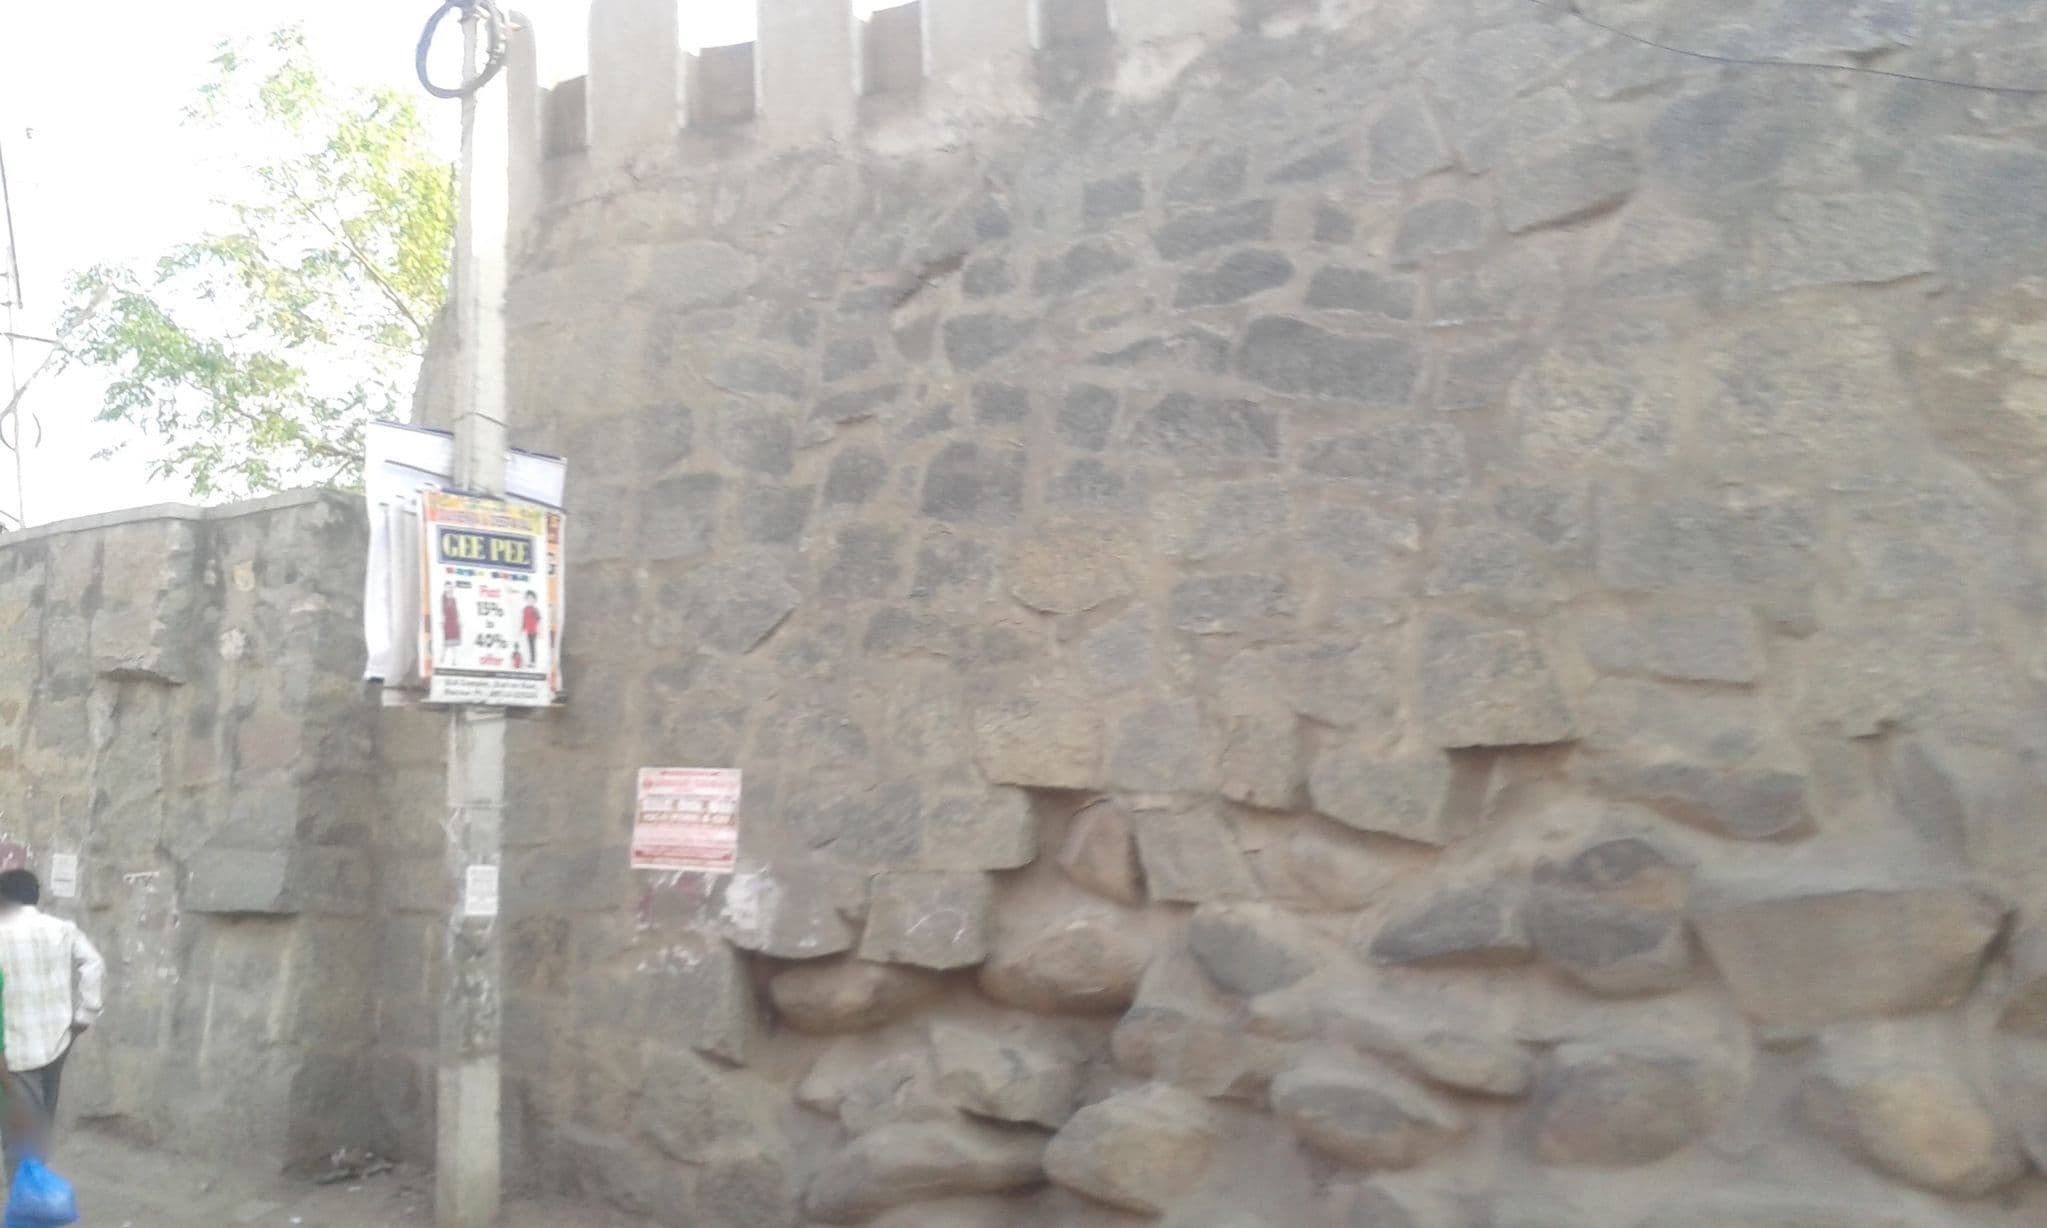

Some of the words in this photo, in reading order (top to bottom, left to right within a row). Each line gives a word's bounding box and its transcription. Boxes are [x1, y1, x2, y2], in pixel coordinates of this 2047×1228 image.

[442, 532, 486, 561] GEE
[490, 537, 532, 566] PEE
[476, 600, 505, 618] 15%
[474, 632, 509, 649] 40%
